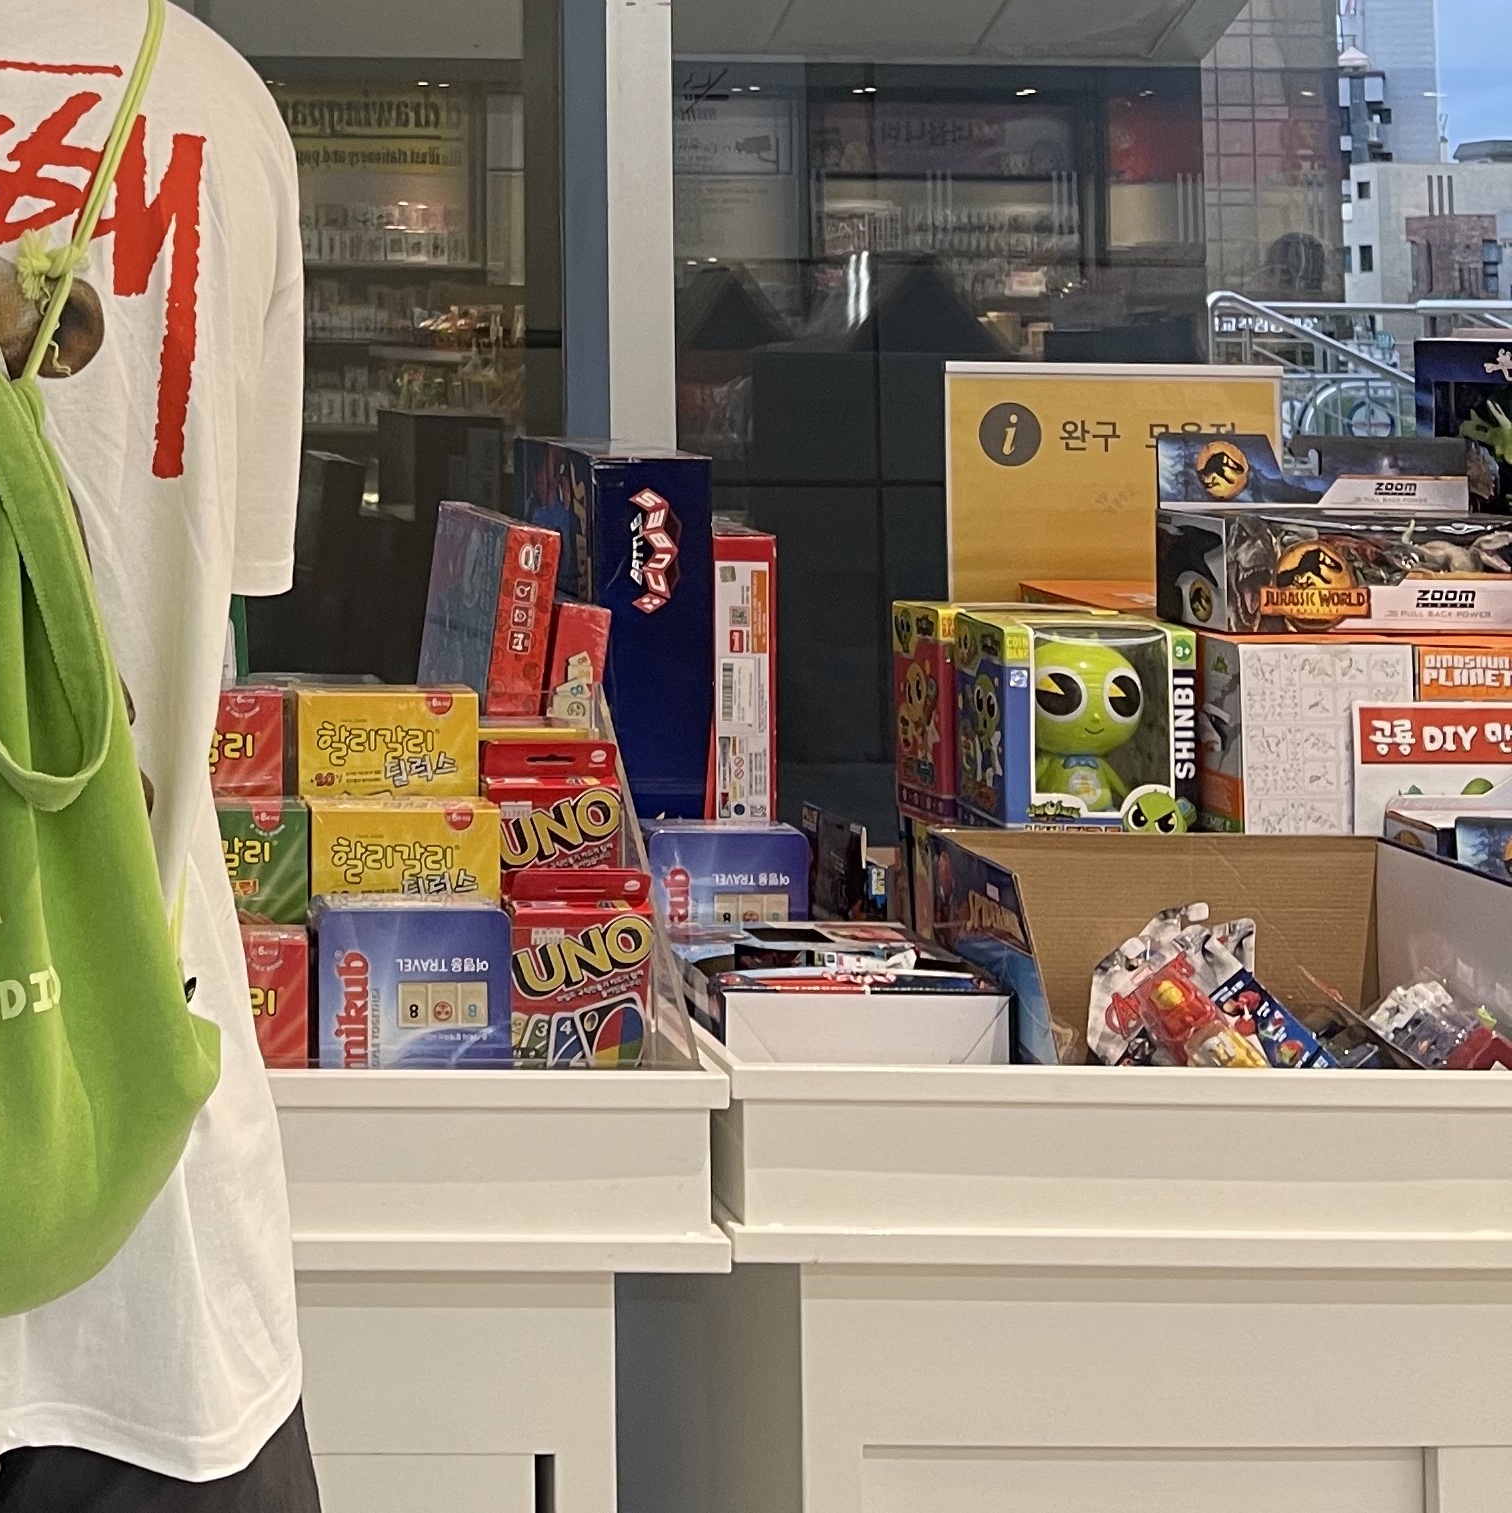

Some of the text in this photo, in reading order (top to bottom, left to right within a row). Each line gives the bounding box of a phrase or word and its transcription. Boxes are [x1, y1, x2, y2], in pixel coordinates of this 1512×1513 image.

[1059, 420, 1121, 453] 완구
[1375, 482, 1417, 492] ZOOM
[630, 512, 644, 586] BATTLE
[634, 491, 673, 593] CUBES
[1264, 590, 1366, 608] JURASSIC WORLD
[1416, 589, 1477, 603] ZOOM
[316, 720, 435, 767] 할리갈리
[1173, 676, 1196, 780] SHINBI
[1369, 718, 1417, 756] 공룡
[1422, 724, 1478, 752] DIY
[500, 787, 621, 870] UNO
[330, 836, 454, 885] 할리갈리
[712, 873, 756, 886] TRAVEL
[395, 957, 490, 973] 여행용 TRAVEL
[511, 913, 652, 1000] UNO
[535, 1022, 549, 1037] 3
[559, 1019, 573, 1035] 4
